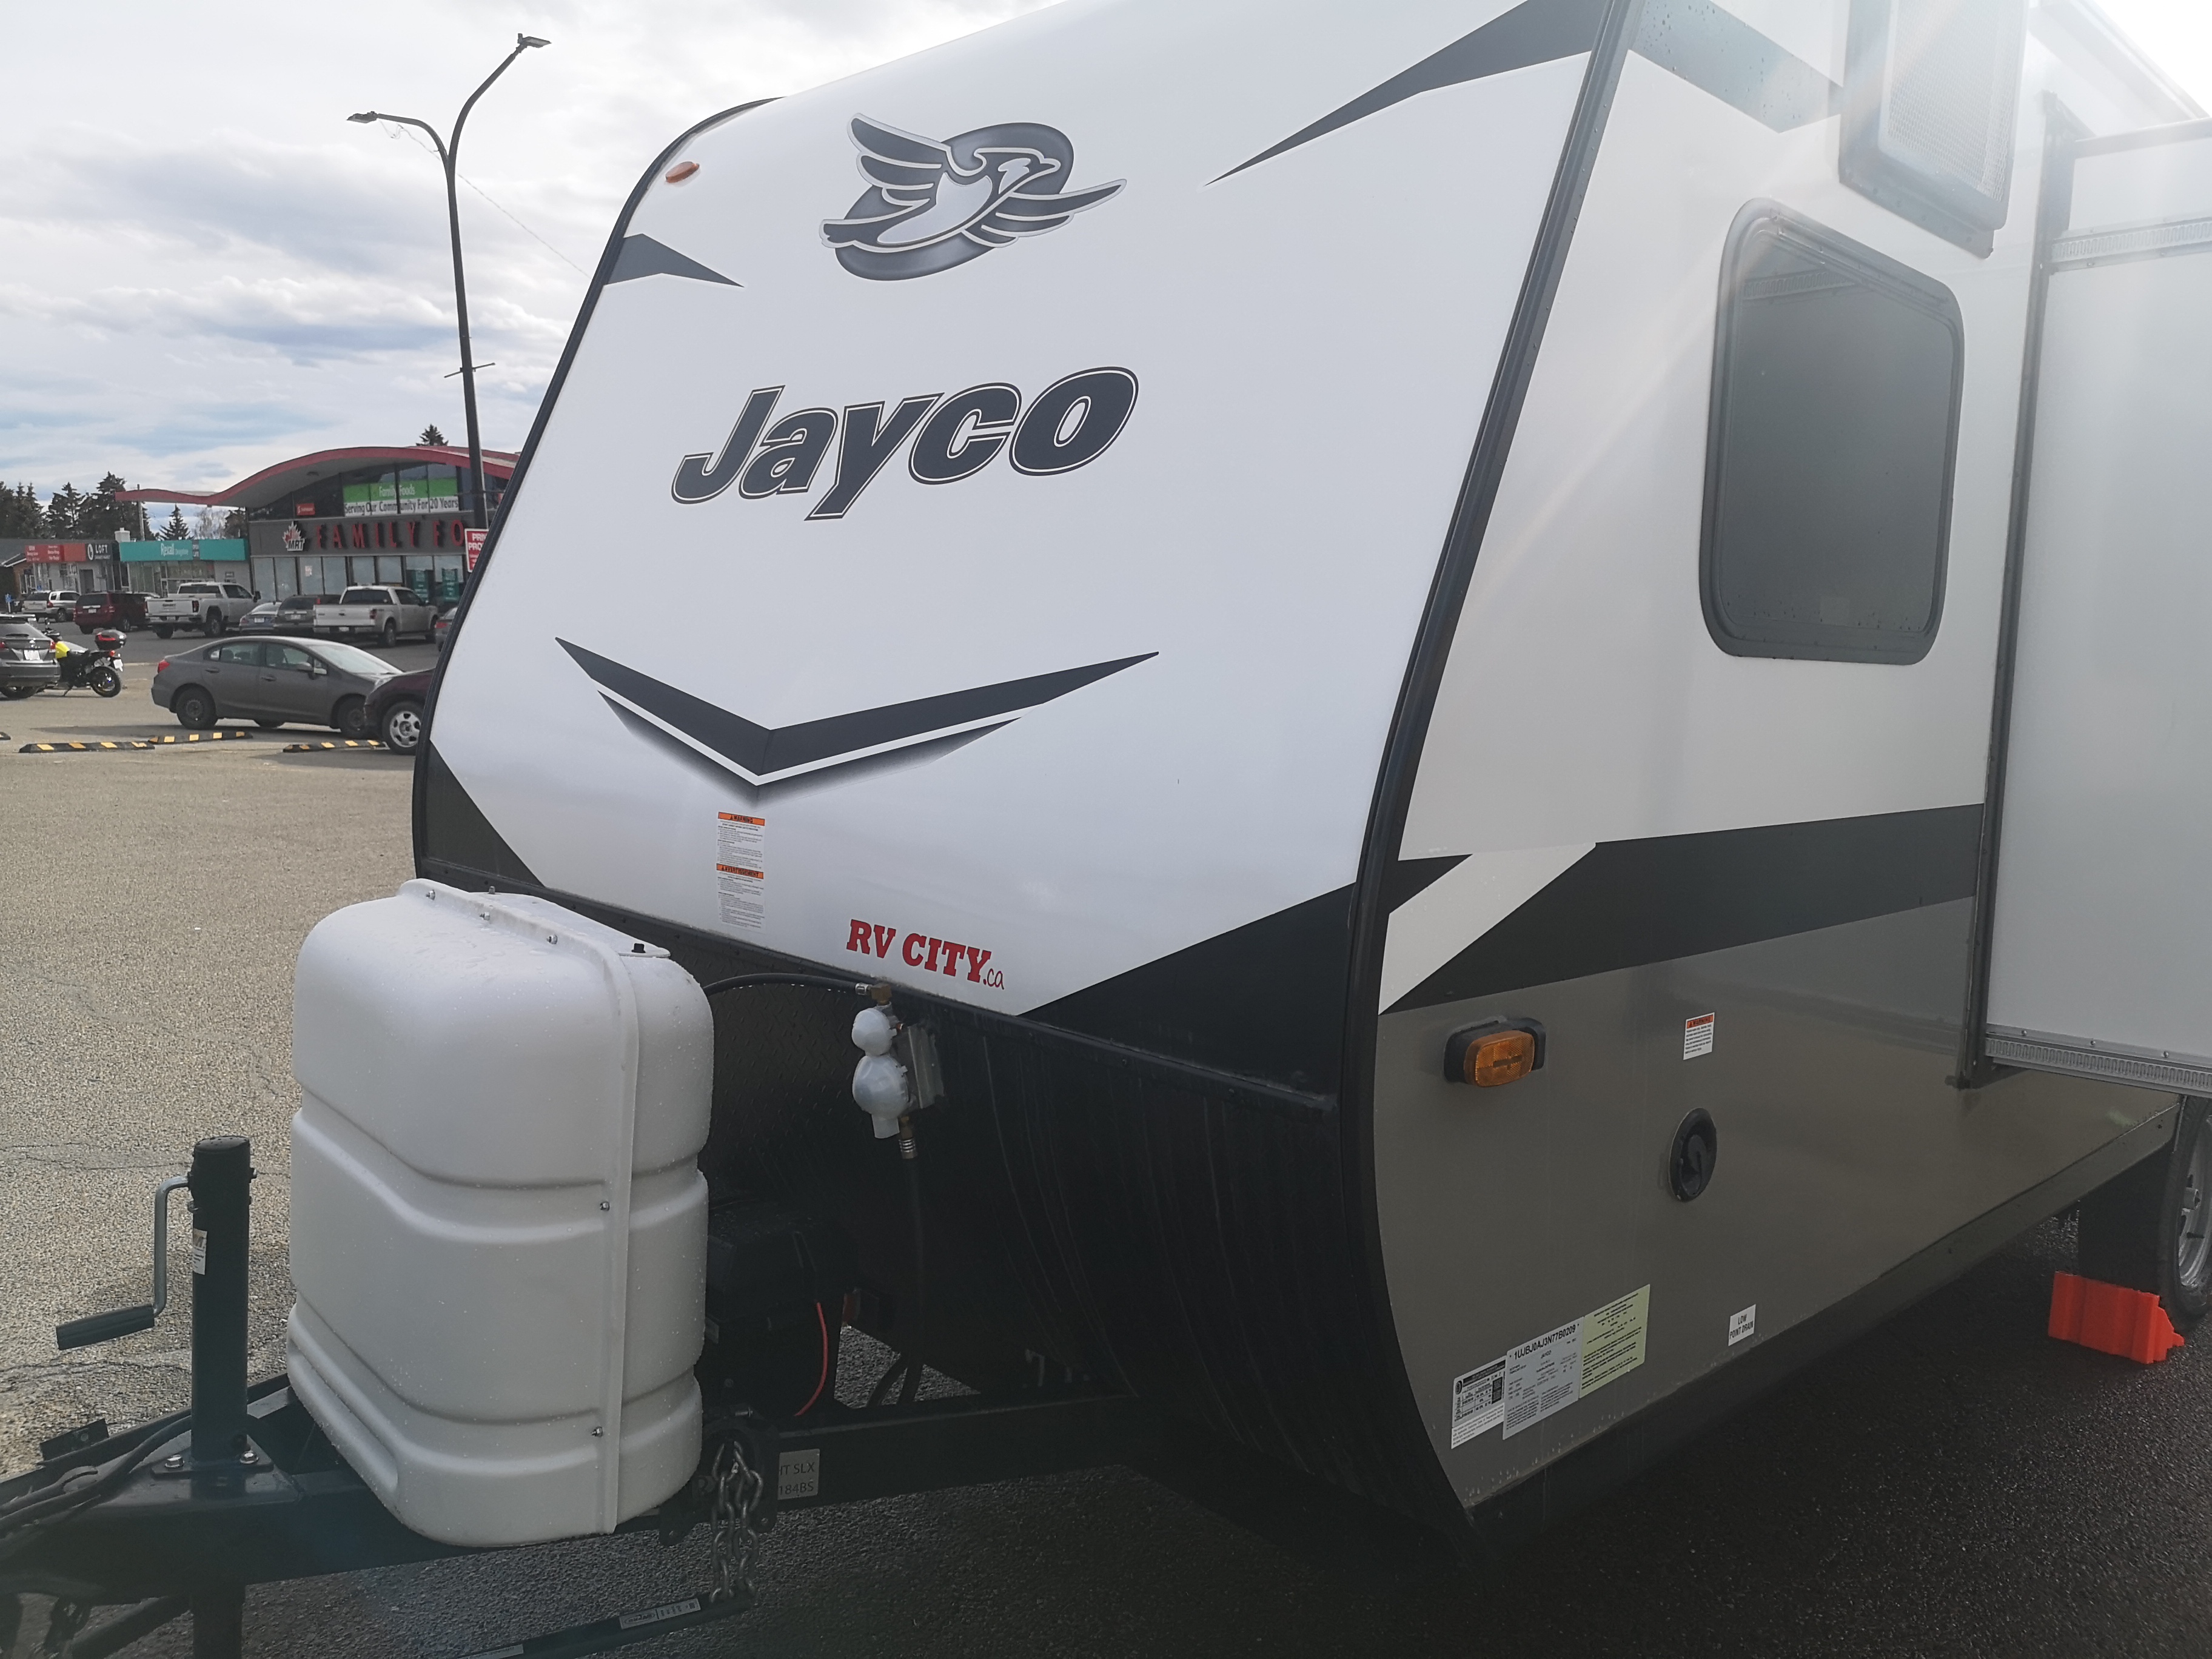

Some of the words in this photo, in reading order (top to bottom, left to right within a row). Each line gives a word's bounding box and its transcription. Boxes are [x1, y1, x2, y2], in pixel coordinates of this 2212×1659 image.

[671, 366, 1139, 521] Jayco
[399, 484, 415, 495] Foods
[344, 503, 365, 515] Serving
[380, 500, 416, 513] Community
[418, 499, 428, 509] For
[431, 498, 438, 509] 20
[440, 497, 458, 508] Years
[317, 521, 416, 548] FAMILY
[432, 520, 464, 546] FO
[95, 545, 108, 554] LOFT
[468, 542, 483, 551] PRO
[846, 919, 896, 959] RV
[794, 1462, 815, 1474] SLX
[779, 1481, 814, 1495] 184BS
